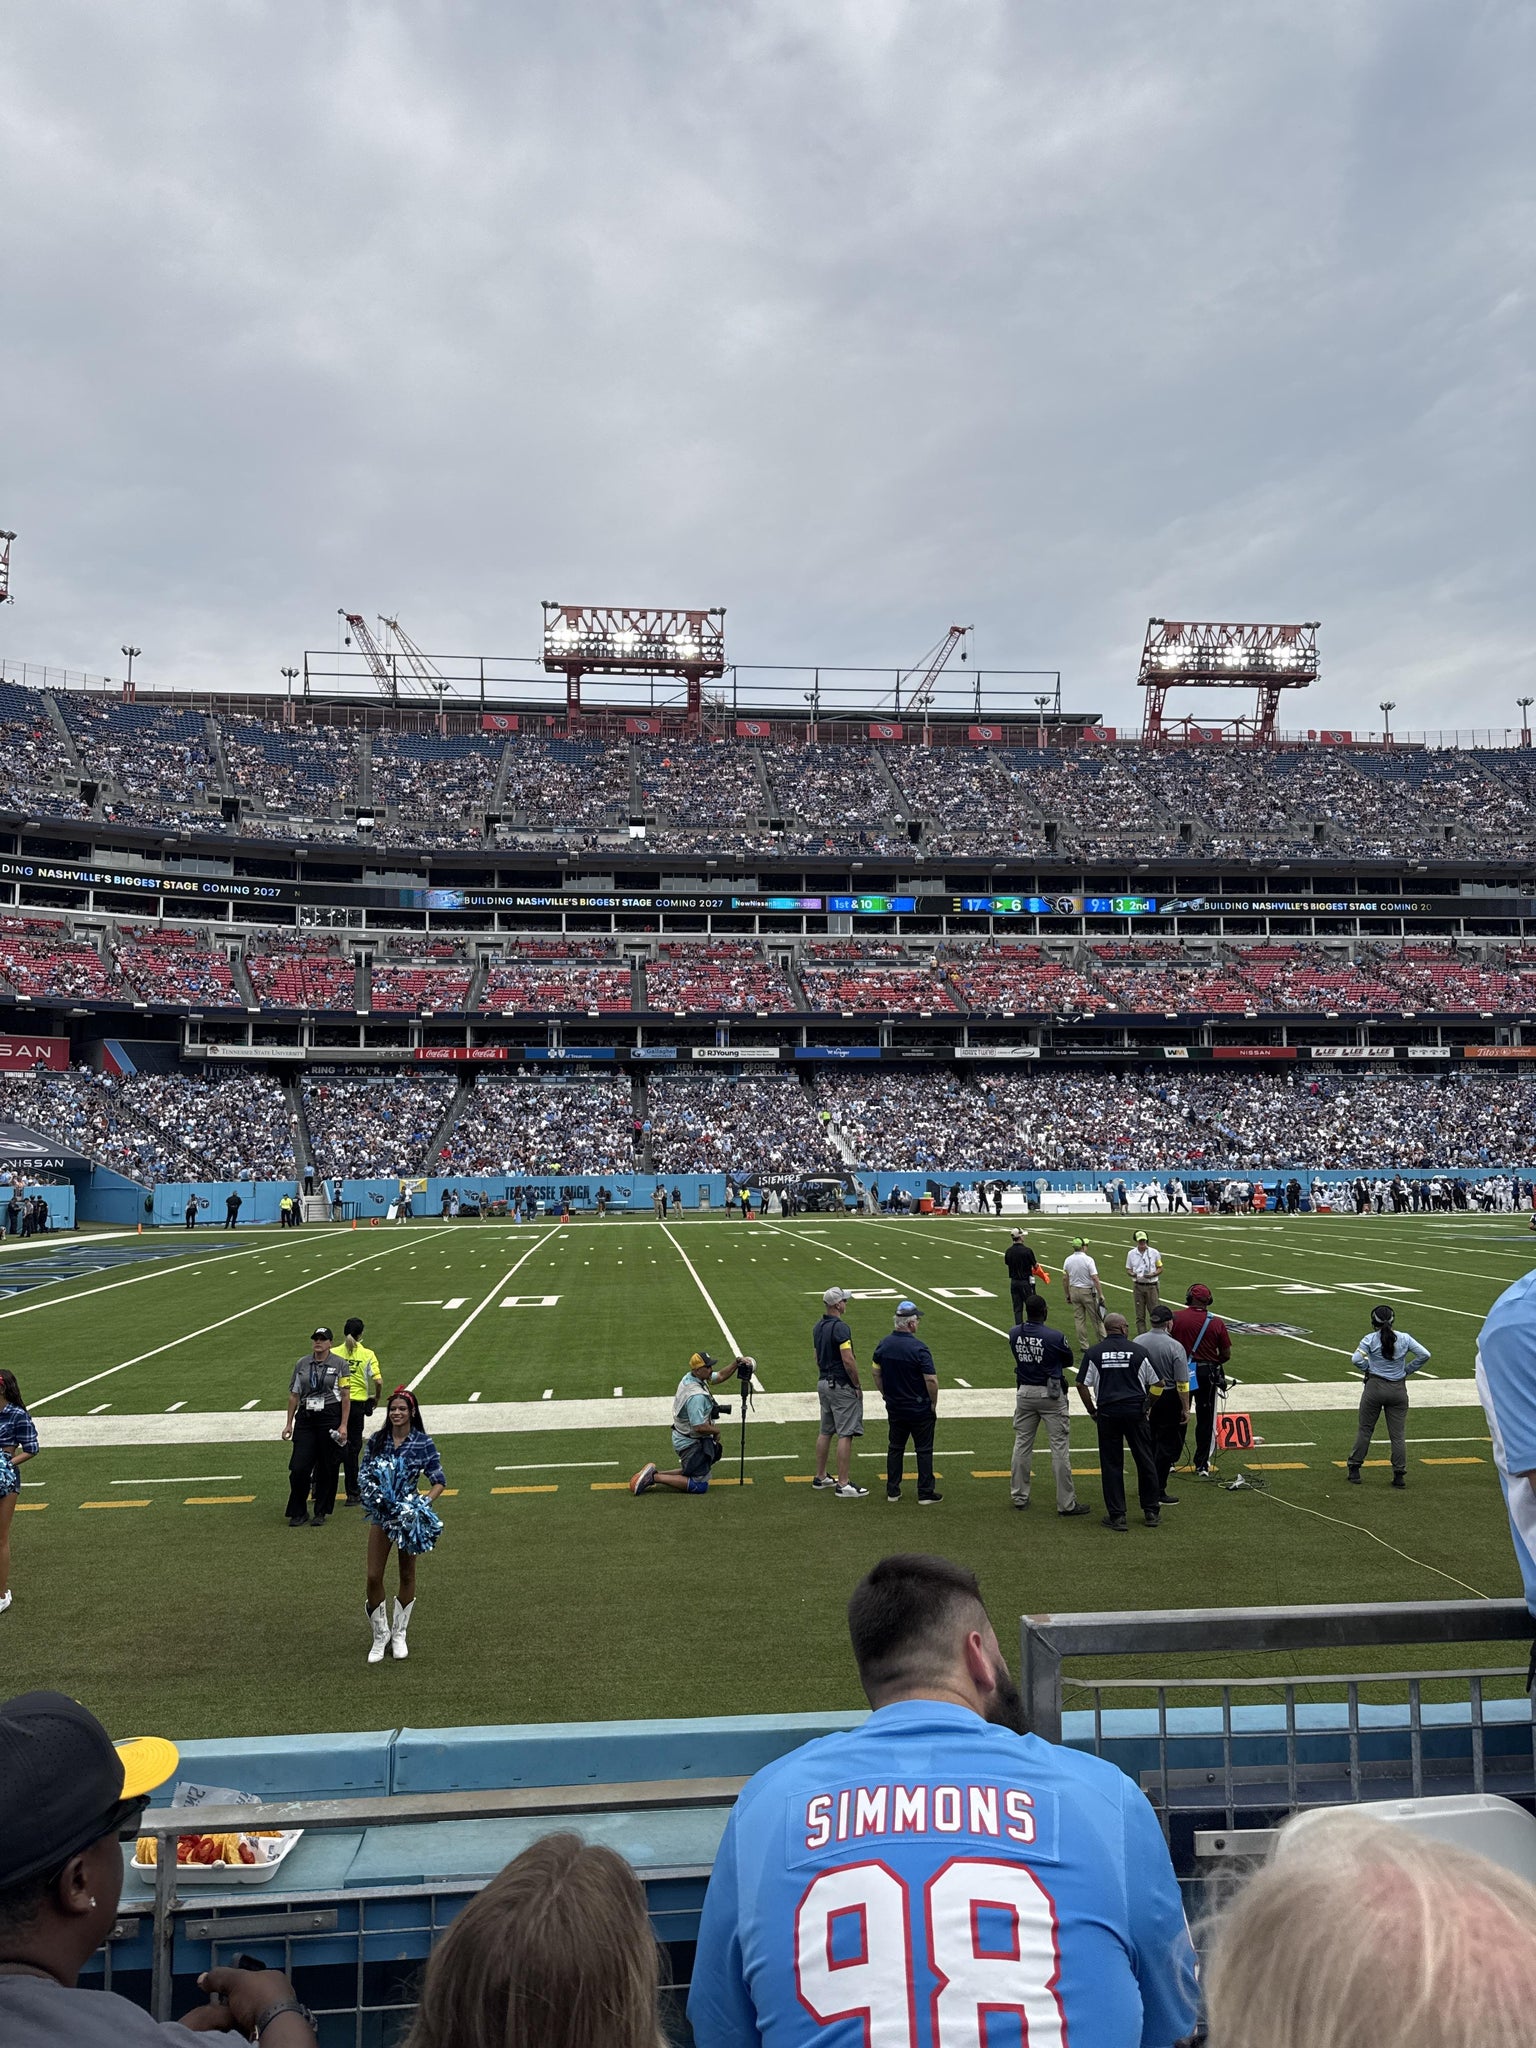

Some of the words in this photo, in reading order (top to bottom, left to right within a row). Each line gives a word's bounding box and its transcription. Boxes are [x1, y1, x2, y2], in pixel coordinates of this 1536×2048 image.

[38, 868, 112, 883] NASHVILLE'S
[114, 876, 161, 888] BIGGEST
[163, 880, 199, 891] STAGE
[202, 883, 250, 895] COMING
[253, 887, 281, 896] 2027
[464, 896, 513, 905] BUILDING
[516, 897, 578, 906] NASHVILLE'S
[580, 898, 620, 906] BIGGEST
[622, 898, 652, 907] STAGE
[655, 899, 696, 907] COMING
[699, 900, 723, 908] 2027
[834, 899, 849, 909] 1st
[851, 899, 859, 909] &
[860, 899, 873, 909] 10
[886, 902, 893, 910] 9
[967, 899, 982, 911] 17
[1011, 899, 1022, 911] 6
[1091, 898, 1124, 912] 9:13
[1129, 901, 1149, 910] 2nd
[1204, 902, 1249, 910] BUILDING
[1252, 902, 1309, 910] NASHVILLE'S
[1310, 903, 1348, 911] BIGGEST
[1349, 903, 1377, 911] STAGE
[1380, 903, 1418, 911] COMING
[1477, 1048, 1500, 1057] Tito's
[311, 1066, 336, 1074] RING
[8, 1159, 64, 1168] NISSAN
[559, 1186, 589, 1199] TUGH
[1016, 1335, 1043, 1347] APEX
[1101, 1351, 1133, 1360] BEST
[1221, 1416, 1251, 1447] 20
[806, 1785, 1037, 1850] SIMMONS
[794, 1856, 1069, 2048] 98
